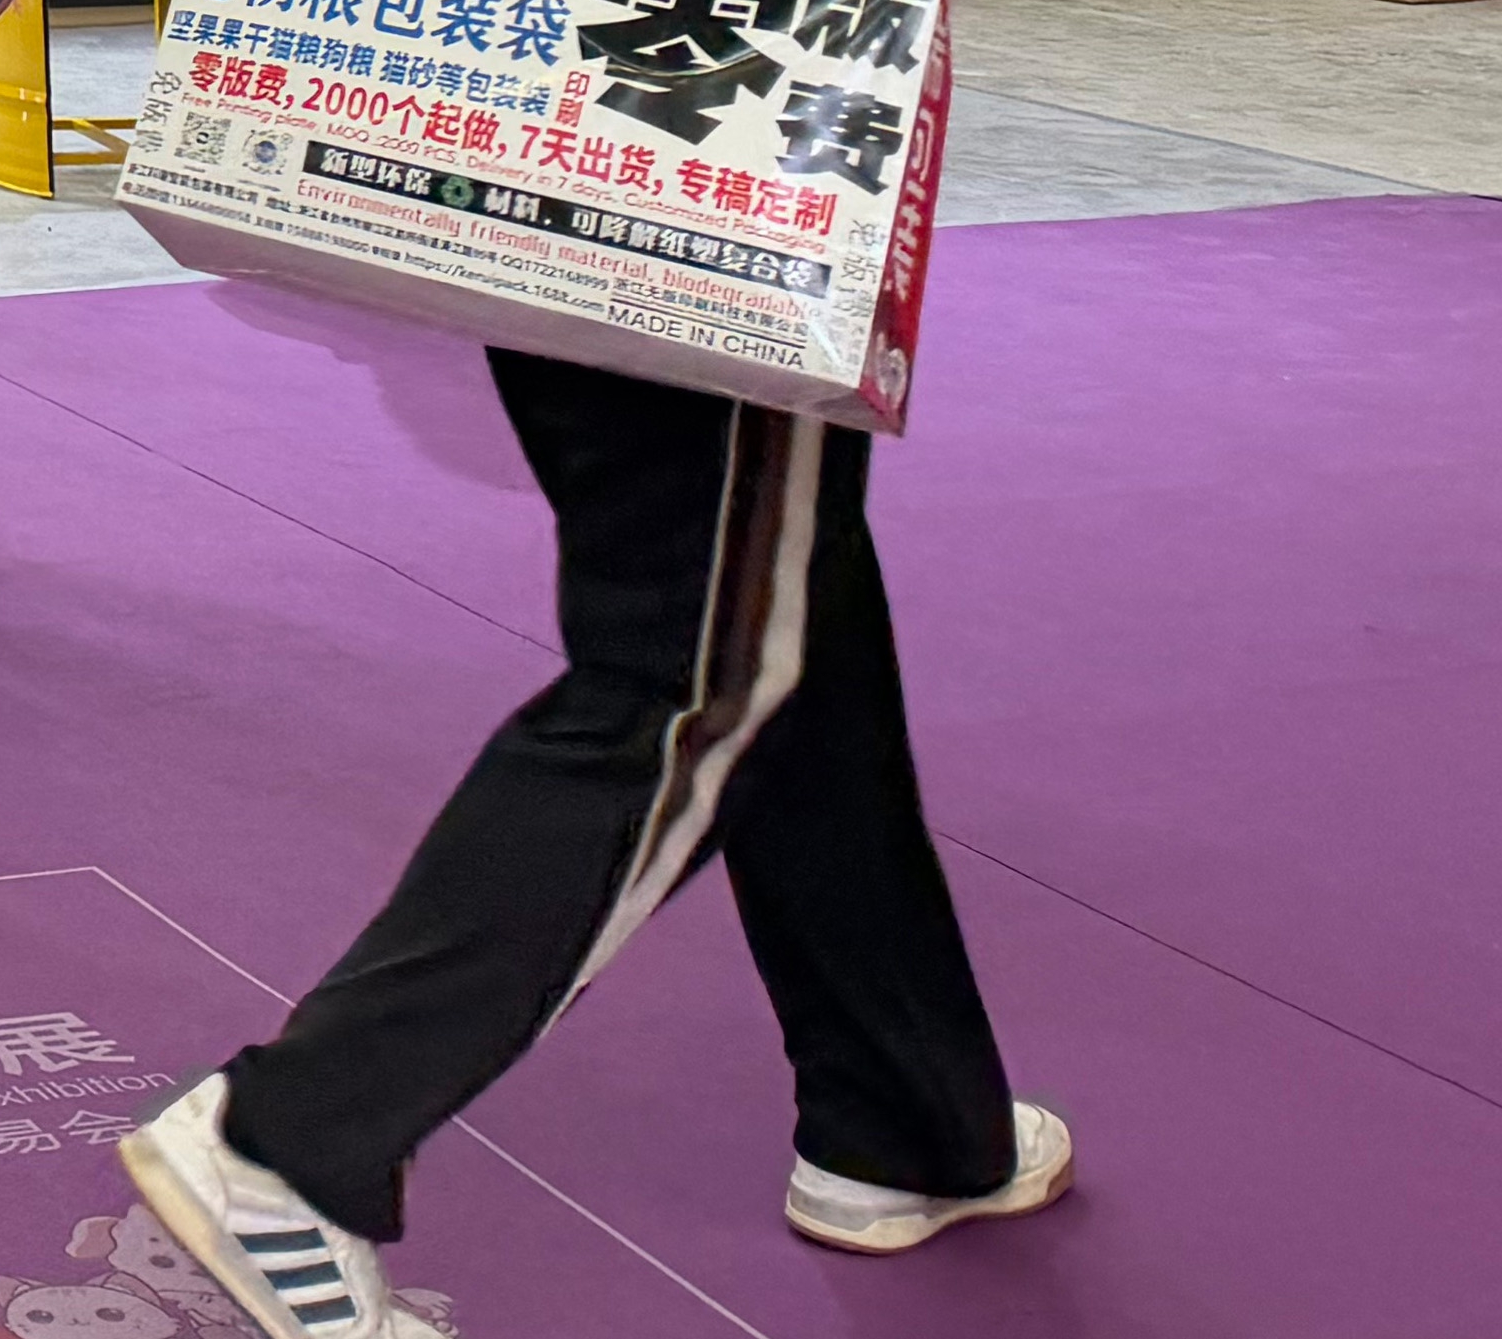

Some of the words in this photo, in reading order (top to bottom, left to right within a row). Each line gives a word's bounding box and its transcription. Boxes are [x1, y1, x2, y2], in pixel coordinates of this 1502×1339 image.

[167, 10, 376, 78] 坚果果干猫粮狗粮
[381, 49, 551, 117] 猫砂等包装袋
[320, 148, 432, 196] 新型环保
[557, 175, 568, 190] 7
[296, 179, 461, 238] Environmentally
[469, 219, 551, 261] friendly
[608, 305, 682, 339] MADE
[689, 326, 716, 347] IN
[723, 334, 805, 369] CHINA
